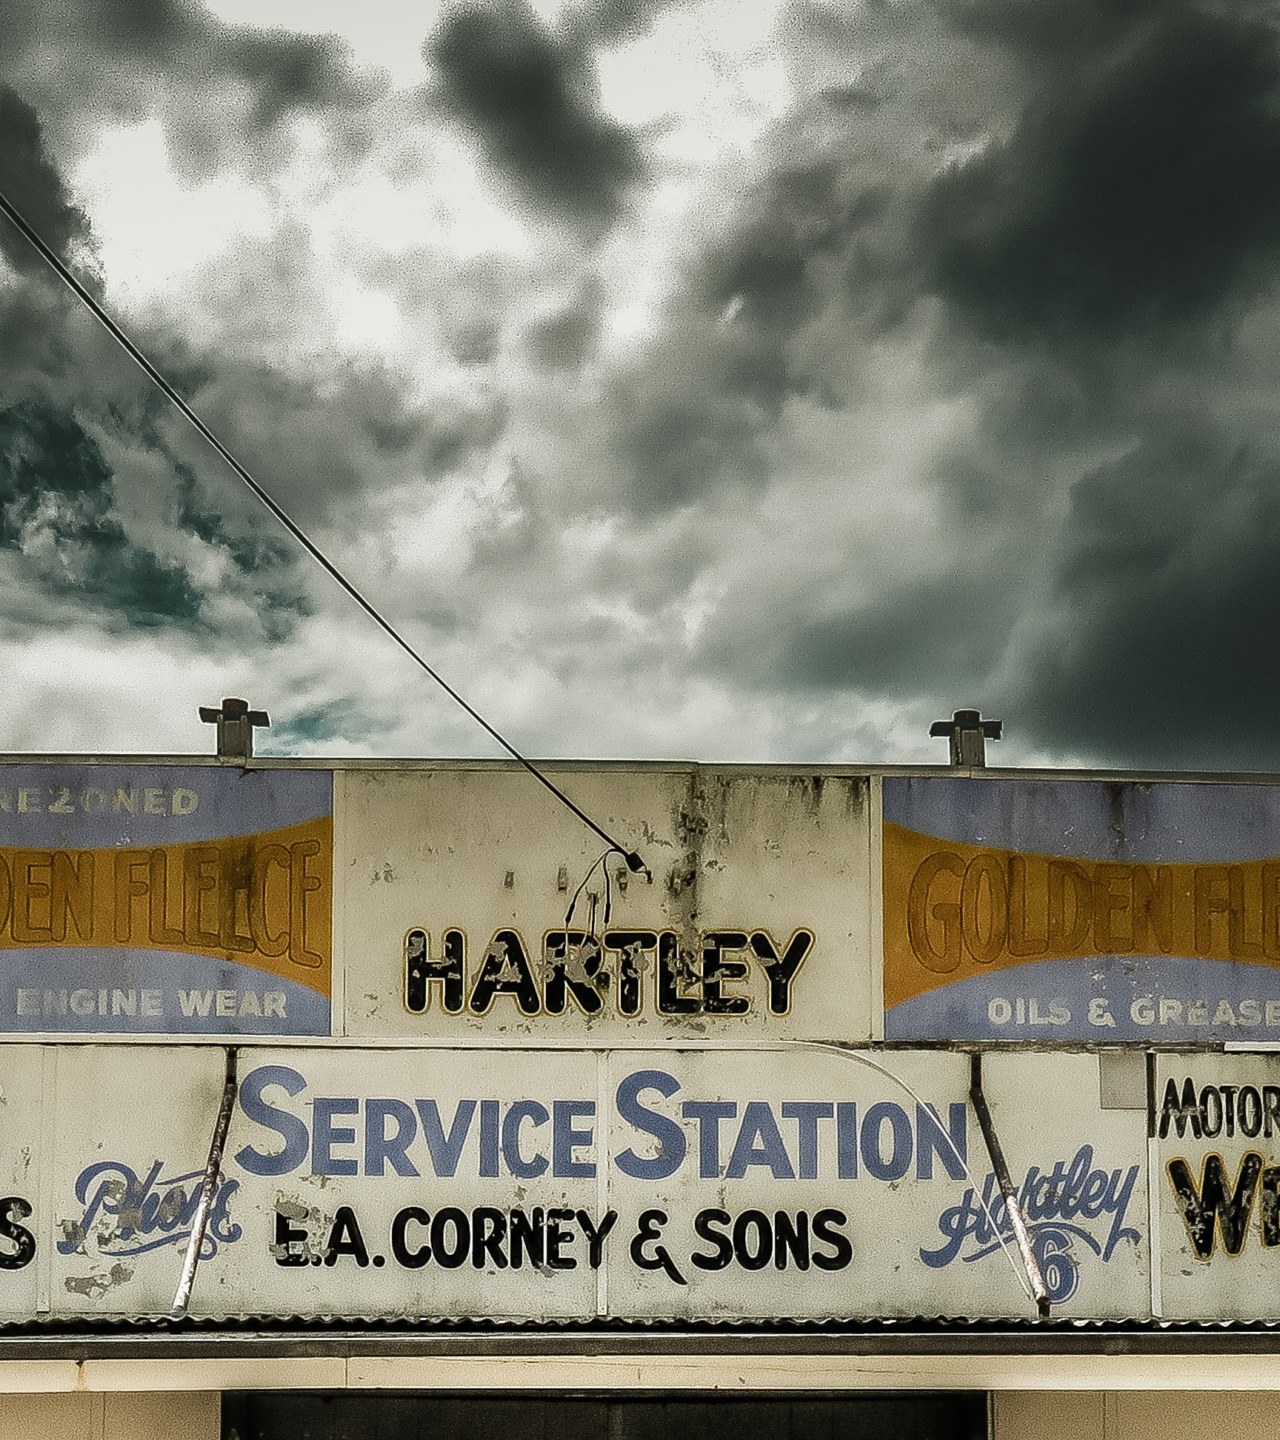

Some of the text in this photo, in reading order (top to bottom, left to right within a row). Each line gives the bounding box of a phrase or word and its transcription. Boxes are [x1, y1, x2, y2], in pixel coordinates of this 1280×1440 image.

[113, 840, 323, 968] FLEECE
[907, 851, 1174, 973] GOLDEN
[16, 988, 164, 1017] ENGINE
[177, 990, 288, 1018] WEAR
[404, 926, 815, 1016] HARTLEY
[987, 998, 1072, 1027] OILS
[1087, 998, 1117, 1029] &
[233, 1064, 967, 1182] SERVICE STATION
[629, 1211, 688, 1285] &
[690, 1208, 853, 1272] SONS
[1033, 1228, 1079, 1305] 6
